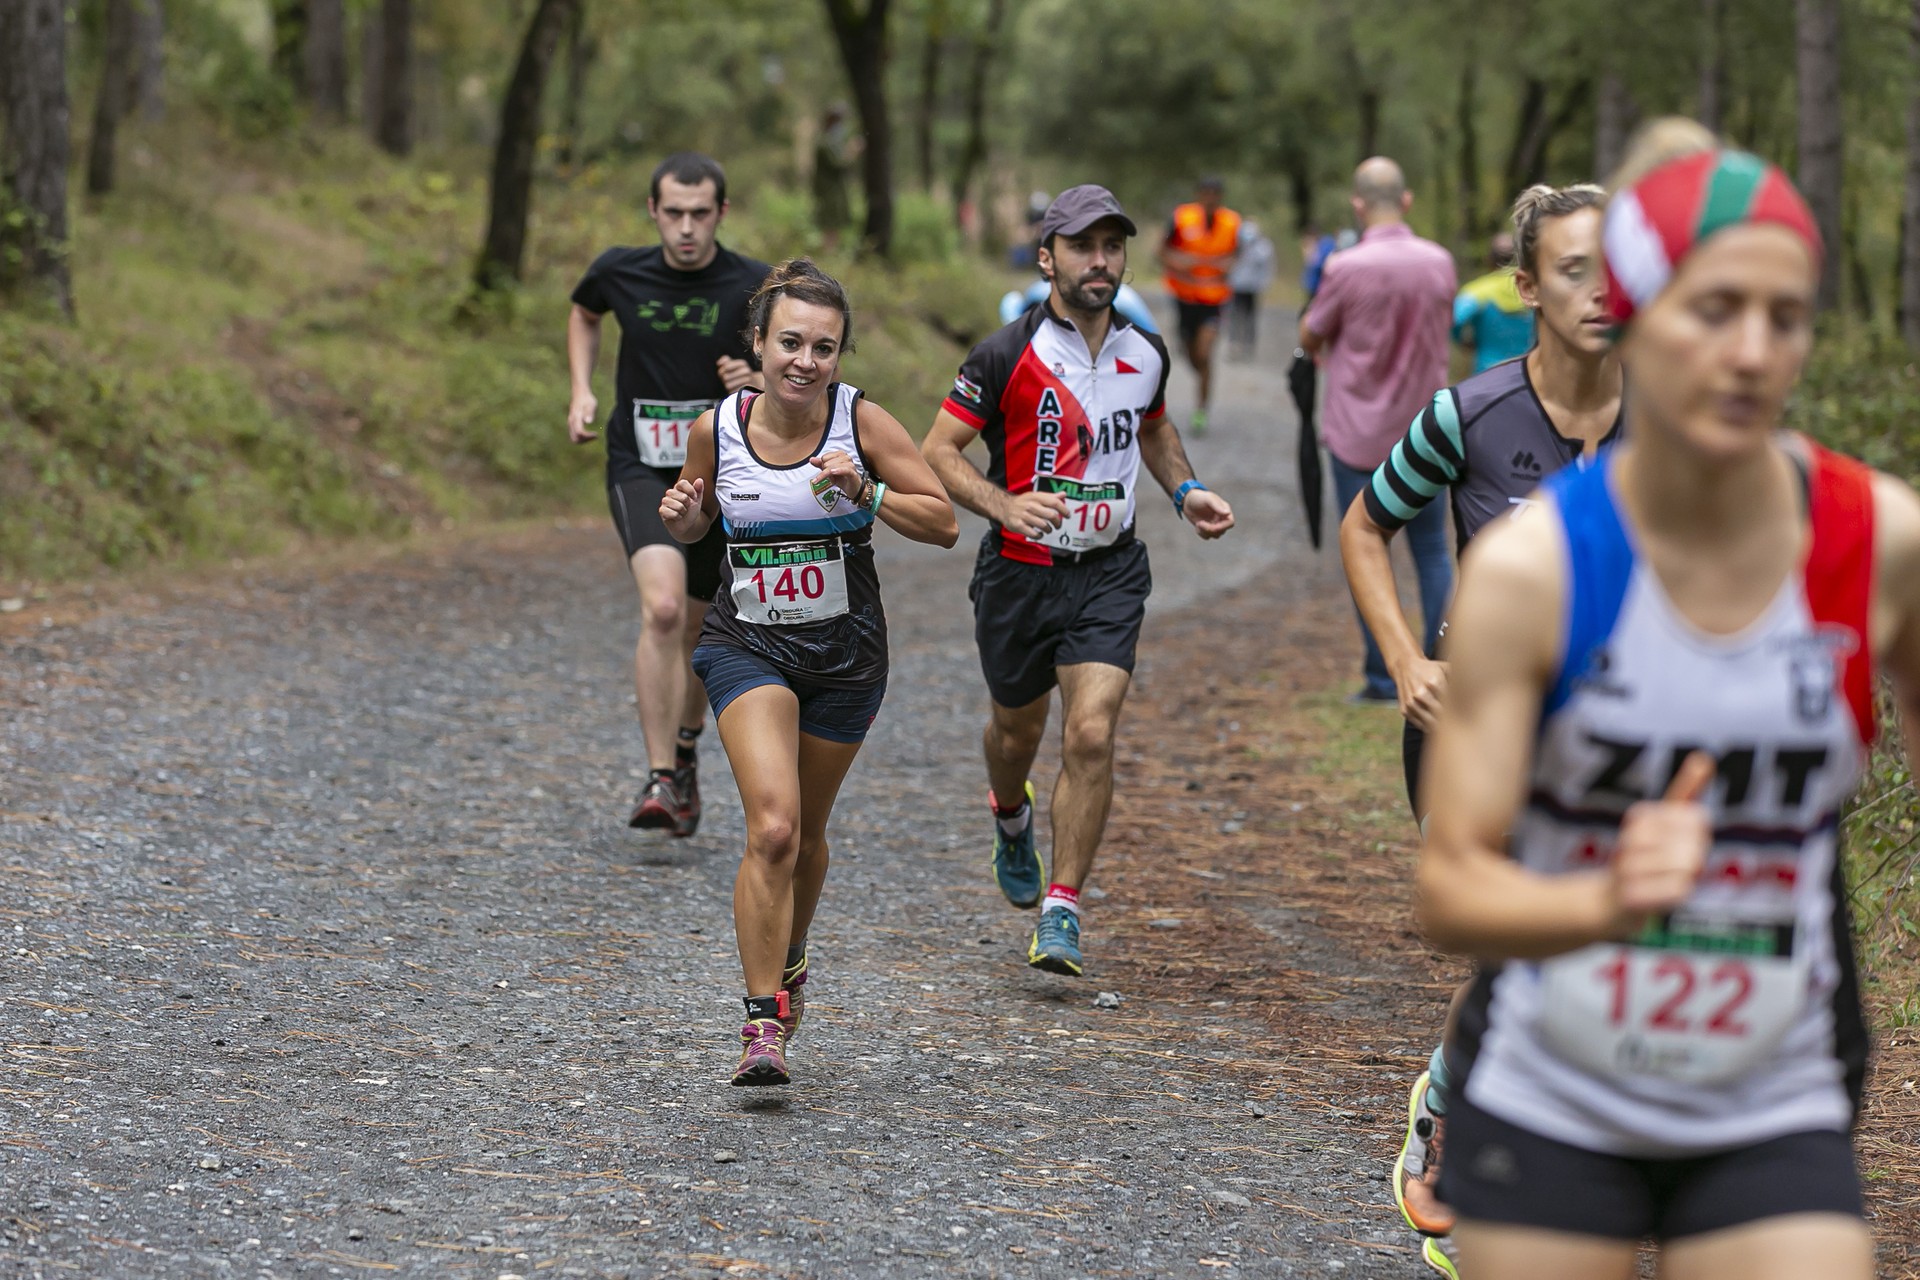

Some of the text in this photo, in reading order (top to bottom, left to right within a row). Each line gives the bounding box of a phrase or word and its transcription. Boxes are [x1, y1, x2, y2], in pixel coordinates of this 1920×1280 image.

[649, 420, 695, 449] 11
[1036, 387, 1063, 475] ARE
[1058, 501, 1112, 533] 10
[751, 565, 825, 604] 140
[1594, 951, 1756, 1037] 122
